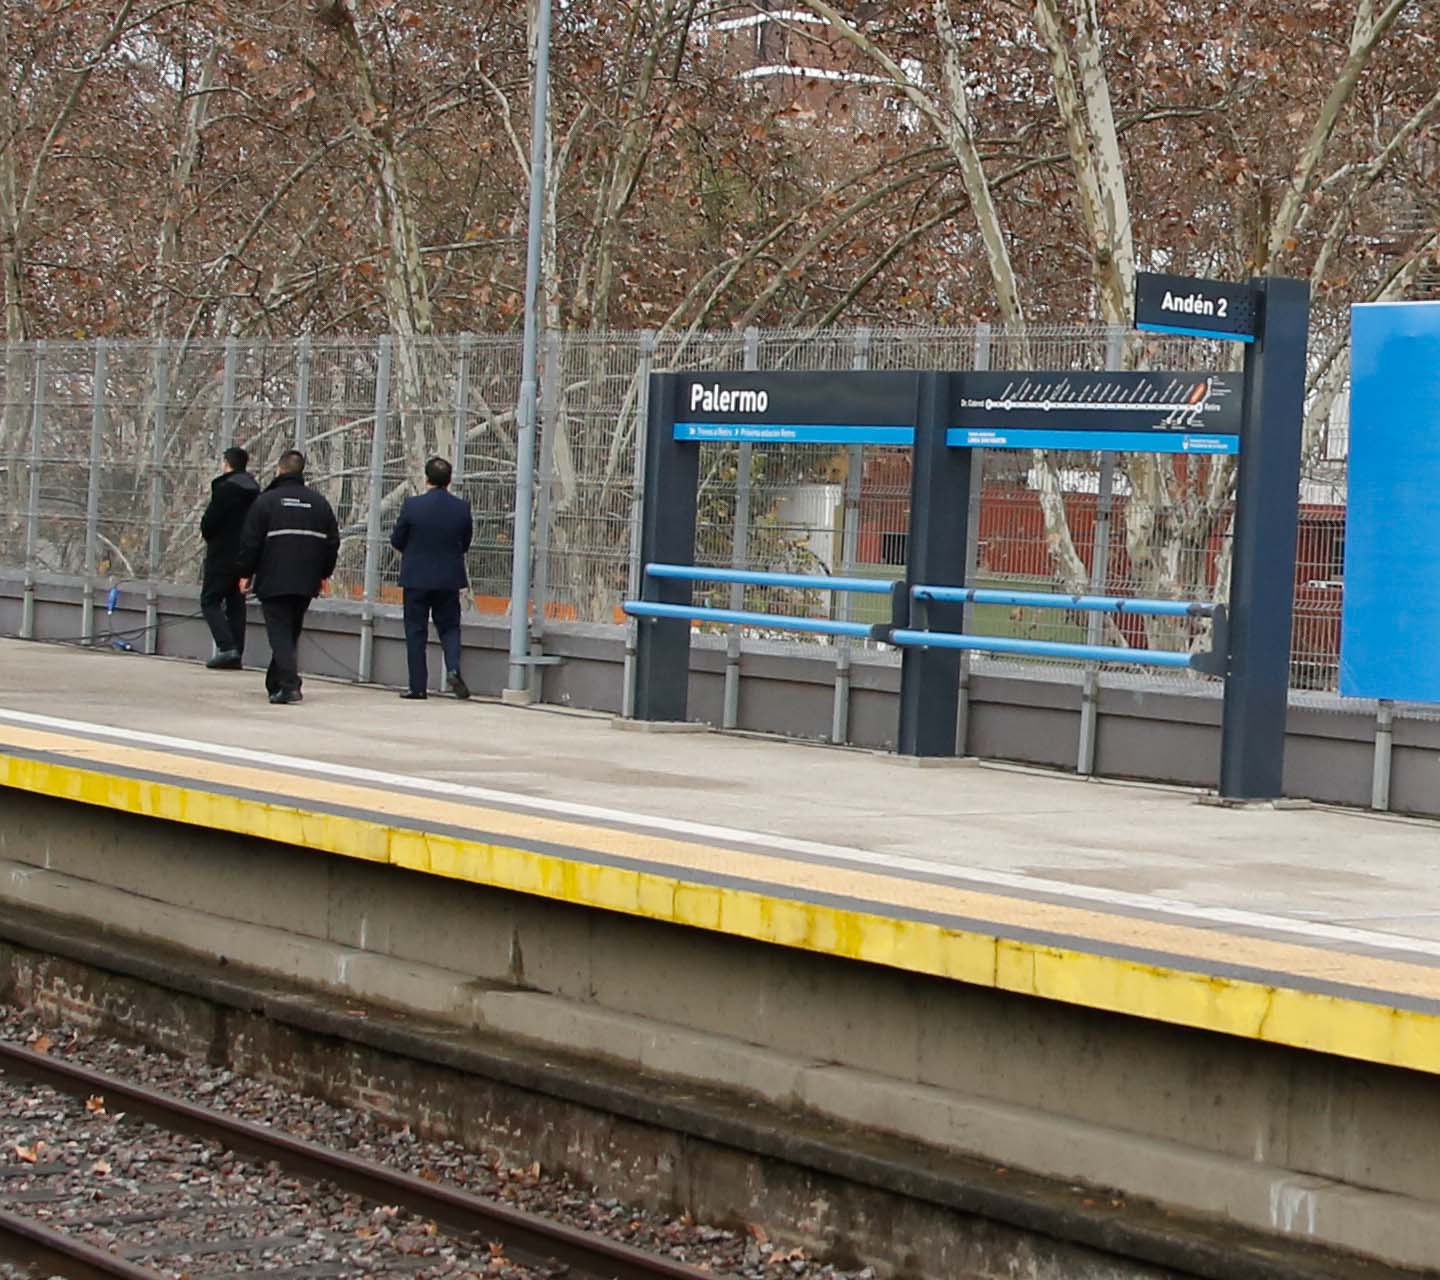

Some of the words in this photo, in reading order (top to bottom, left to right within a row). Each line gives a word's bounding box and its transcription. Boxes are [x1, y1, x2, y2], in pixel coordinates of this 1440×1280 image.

[1161, 291, 1214, 316] Andén
[1217, 298, 1228, 317] 2
[690, 383, 768, 412] Palermo
